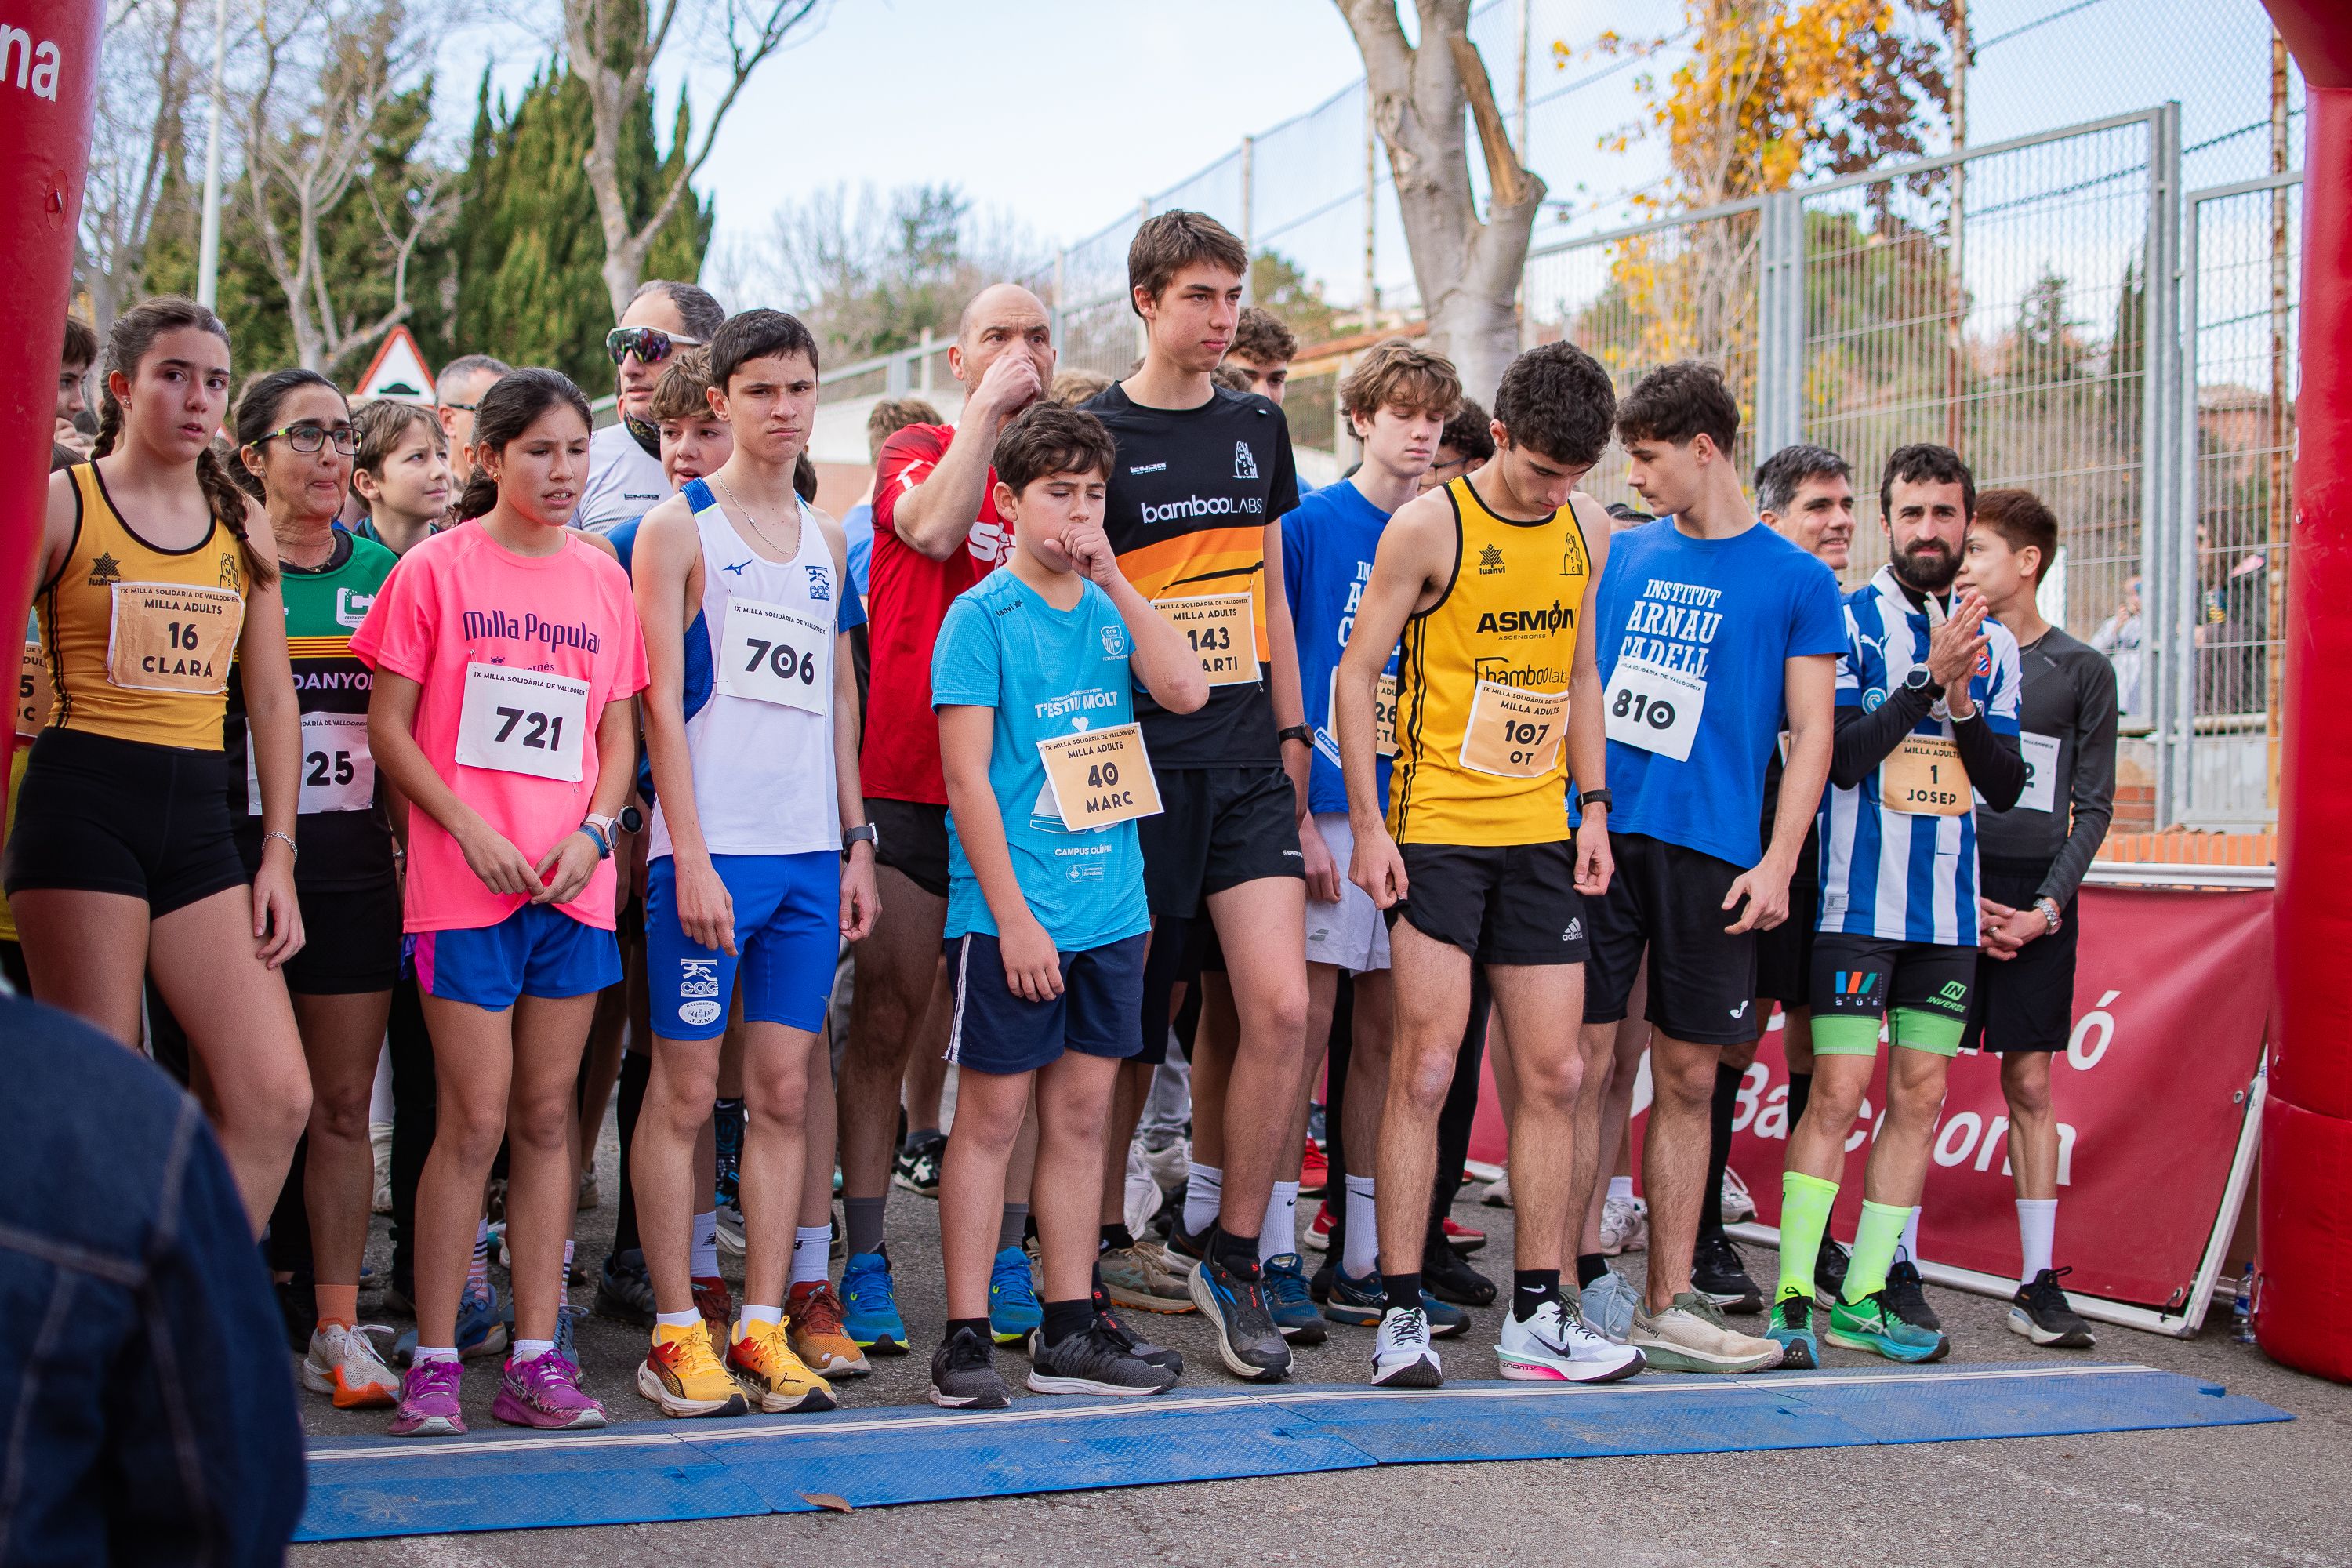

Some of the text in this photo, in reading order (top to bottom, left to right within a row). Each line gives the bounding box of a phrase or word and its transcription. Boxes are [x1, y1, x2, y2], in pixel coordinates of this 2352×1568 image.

[1479, 566, 1505, 575] luanvi
[155, 588, 193, 597] SOLIDÀRIA
[1643, 579, 1722, 608] INSTITUT
[144, 599, 223, 615] MILLA ADULTS
[1173, 608, 1236, 621] MILLA ADULTS
[463, 610, 520, 641] Milla
[764, 612, 795, 623] SOLIDÀRIA
[1625, 600, 1723, 644] ARNAU
[168, 622, 198, 651] 16
[1187, 627, 1230, 652] 143
[142, 656, 213, 677] CLARA
[745, 638, 815, 685] 706
[507, 676, 544, 688] SOLIDÀRIA
[1083, 691, 1117, 710] MOLT
[1491, 688, 1510, 697] MILLA
[1512, 693, 1544, 704] SOLIDÀRIA
[1501, 700, 1559, 715] MILLA ADULTS
[1612, 688, 1675, 730] 810
[494, 706, 563, 752] 721
[1504, 720, 1550, 746] 107
[1073, 735, 1100, 745] SOLIDÀRIA
[1067, 741, 1123, 759] MILLA ADULTS
[1510, 750, 1534, 765] OT
[1904, 746, 1930, 755] MILLA
[306, 750, 354, 786] 25
[1088, 761, 1119, 788] 40
[1930, 764, 1937, 784] 1
[1086, 790, 1134, 813] MARC
[1907, 789, 1956, 805] JOSEP
[1054, 847, 1091, 856] CAMPUS
[1926, 996, 1968, 1013] INVERSE
[1633, 1319, 1660, 1338] saucony
